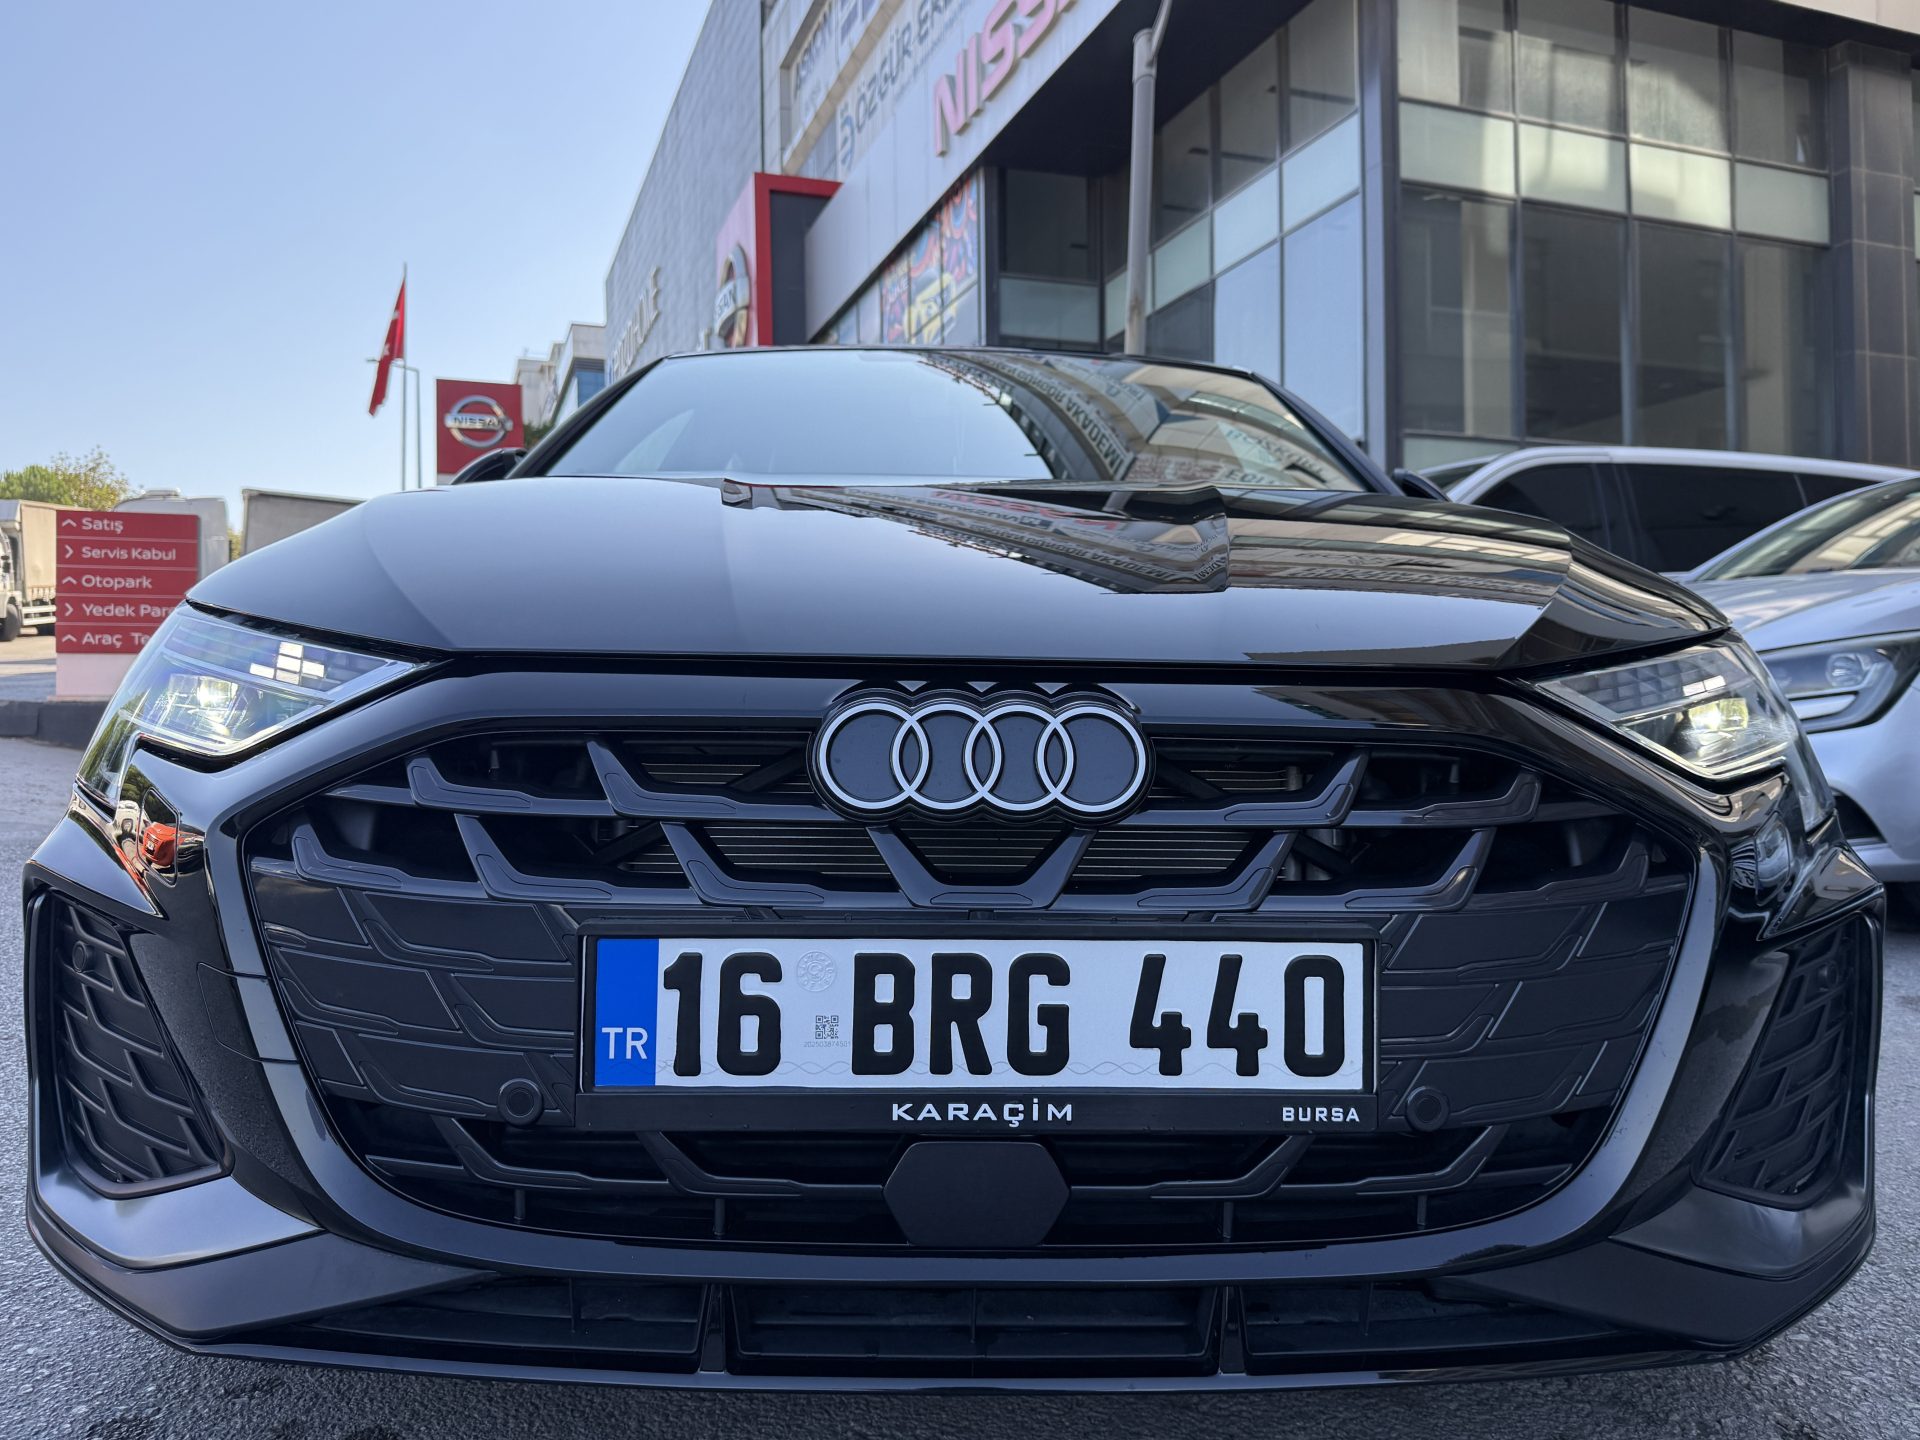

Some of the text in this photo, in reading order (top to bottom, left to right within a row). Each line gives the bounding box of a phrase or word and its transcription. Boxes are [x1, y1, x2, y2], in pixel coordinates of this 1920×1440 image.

[854, 22, 913, 134] ÖZGÜR
[934, 0, 1078, 157] NISS
[81, 517, 124, 534] Satış
[81, 546, 177, 561] Servis Kabul
[81, 574, 153, 590] Otopark
[82, 603, 136, 617] Yedek
[81, 632, 122, 649] Araç
[663, 952, 1345, 1078] 16 BRG 440
[602, 1027, 648, 1060] TR
[892, 1098, 1072, 1128] KARAÇİM
[1282, 1106, 1360, 1122] BURSA
